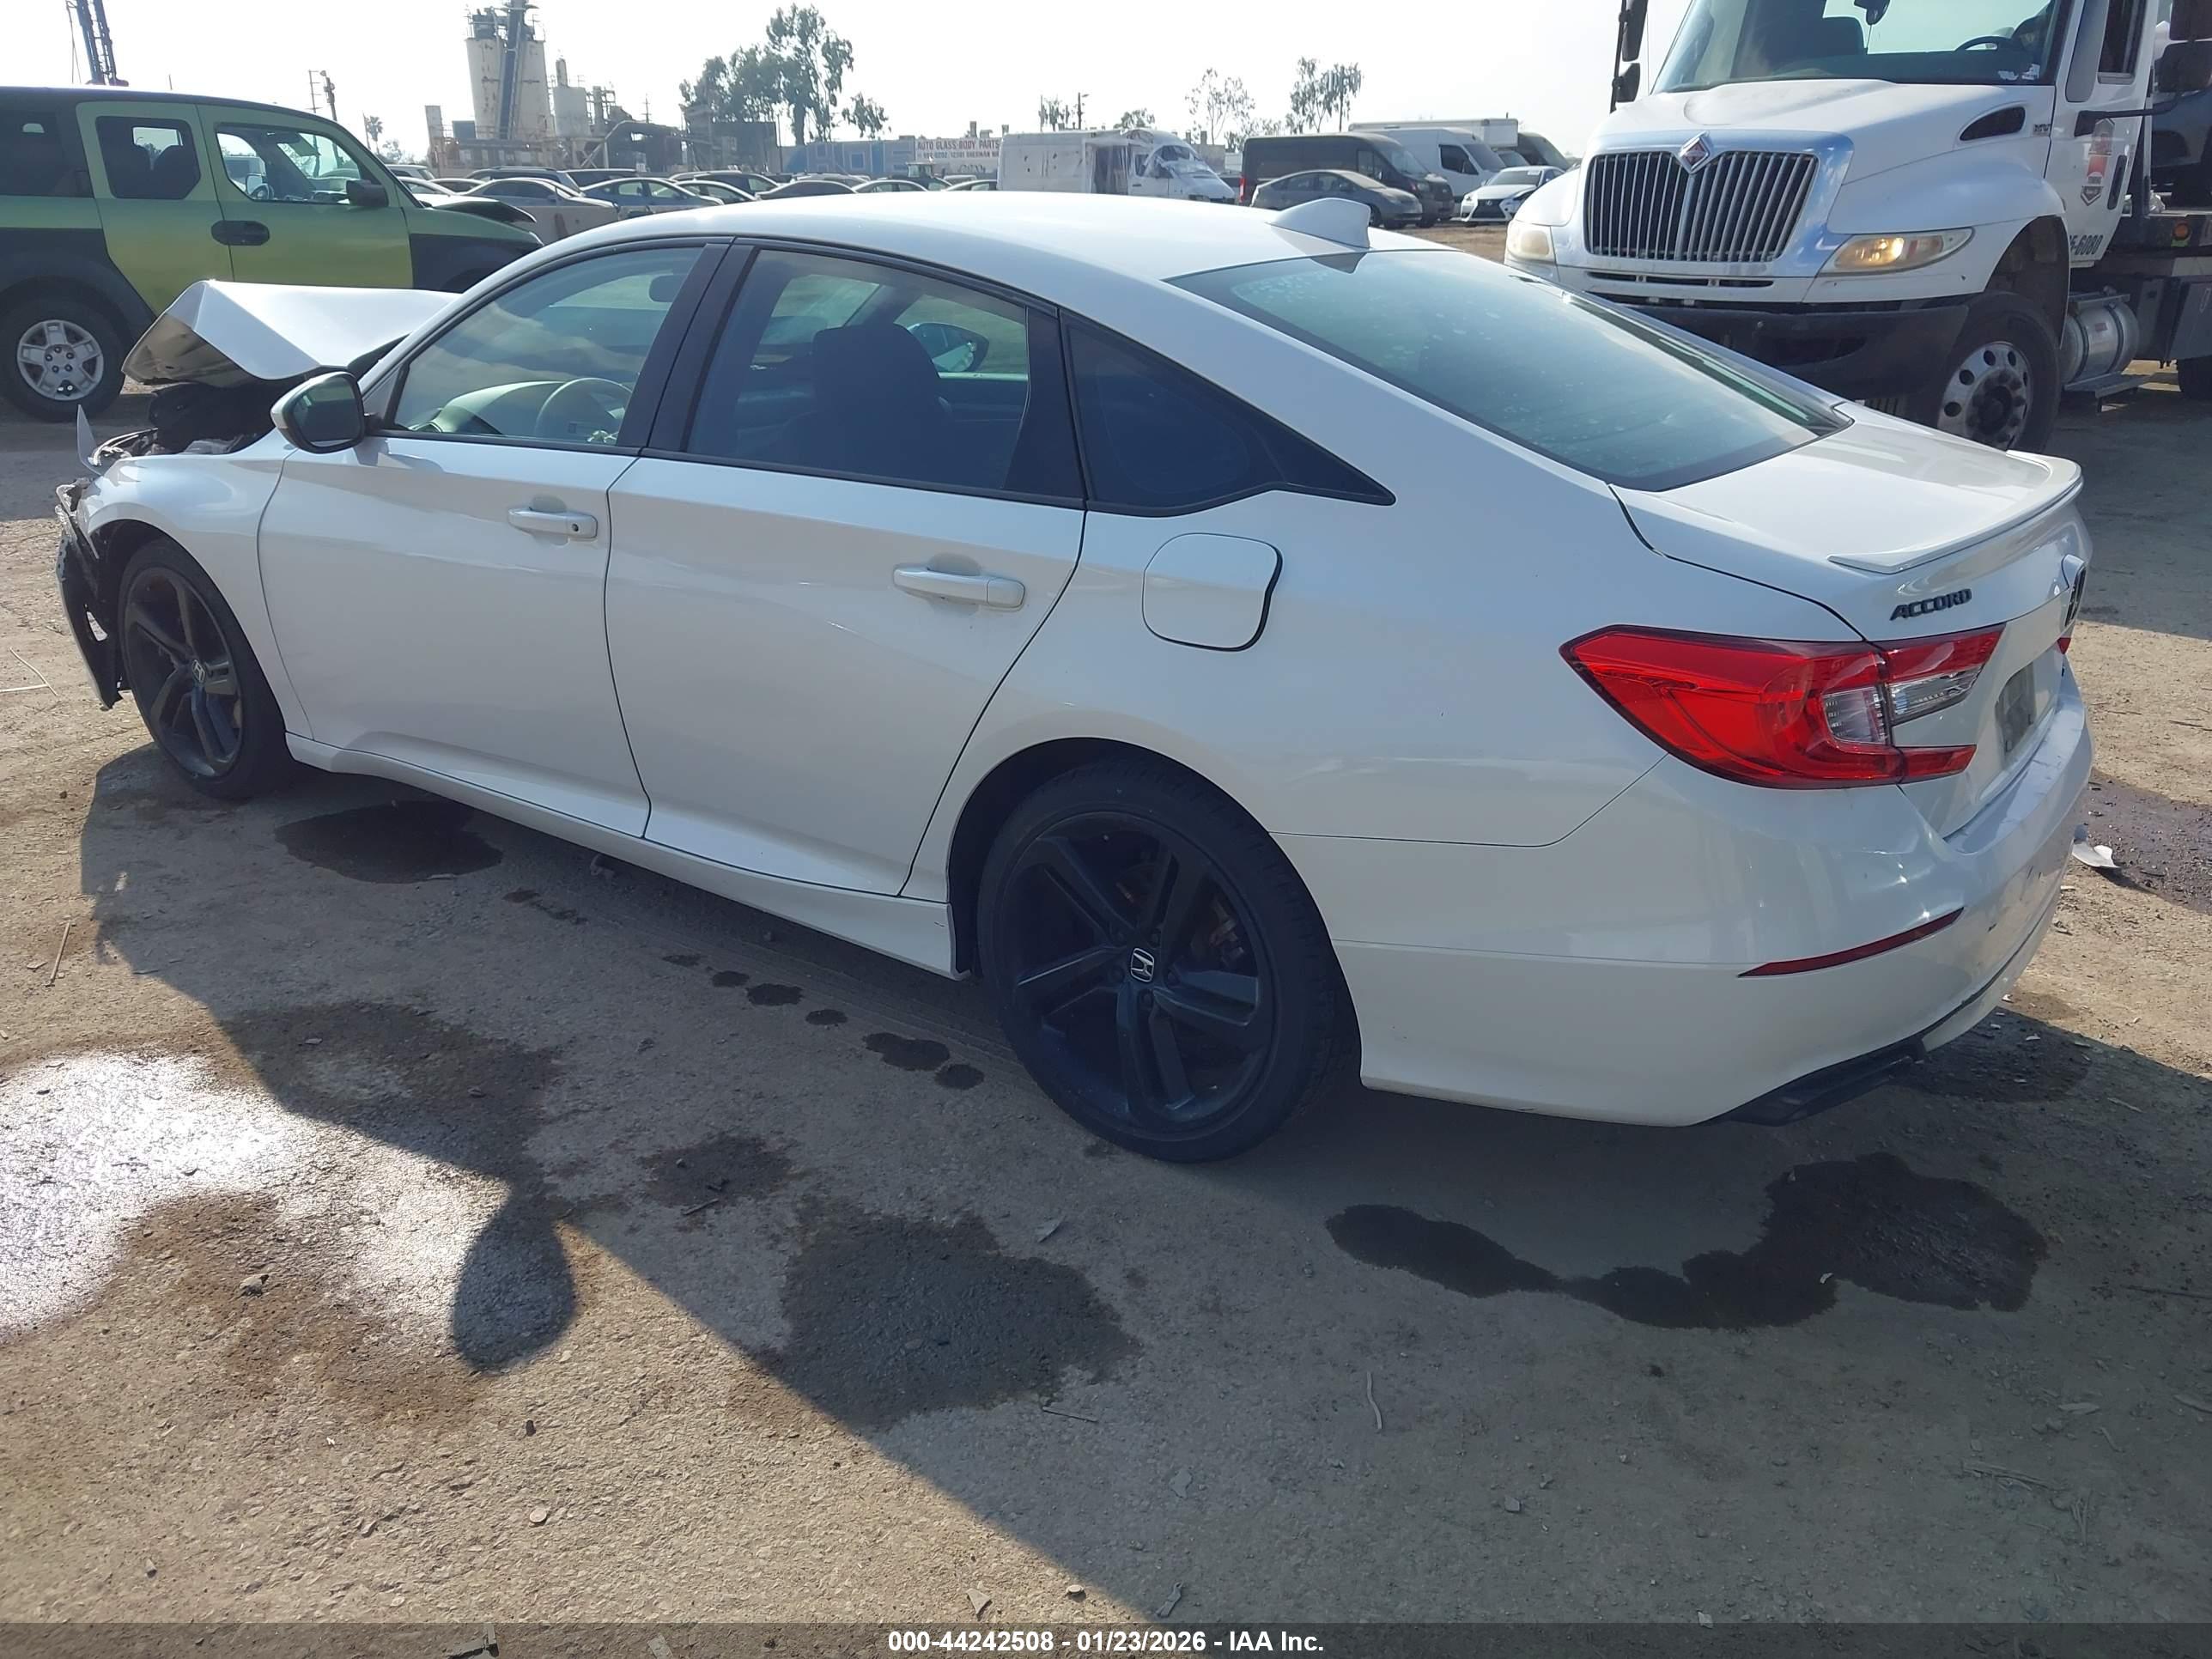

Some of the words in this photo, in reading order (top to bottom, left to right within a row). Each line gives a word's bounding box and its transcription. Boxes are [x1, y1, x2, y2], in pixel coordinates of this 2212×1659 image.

[918, 141, 934, 150] AUTO
[979, 139, 1000, 149] PARTS
[1889, 588, 1972, 621] ACCORD
